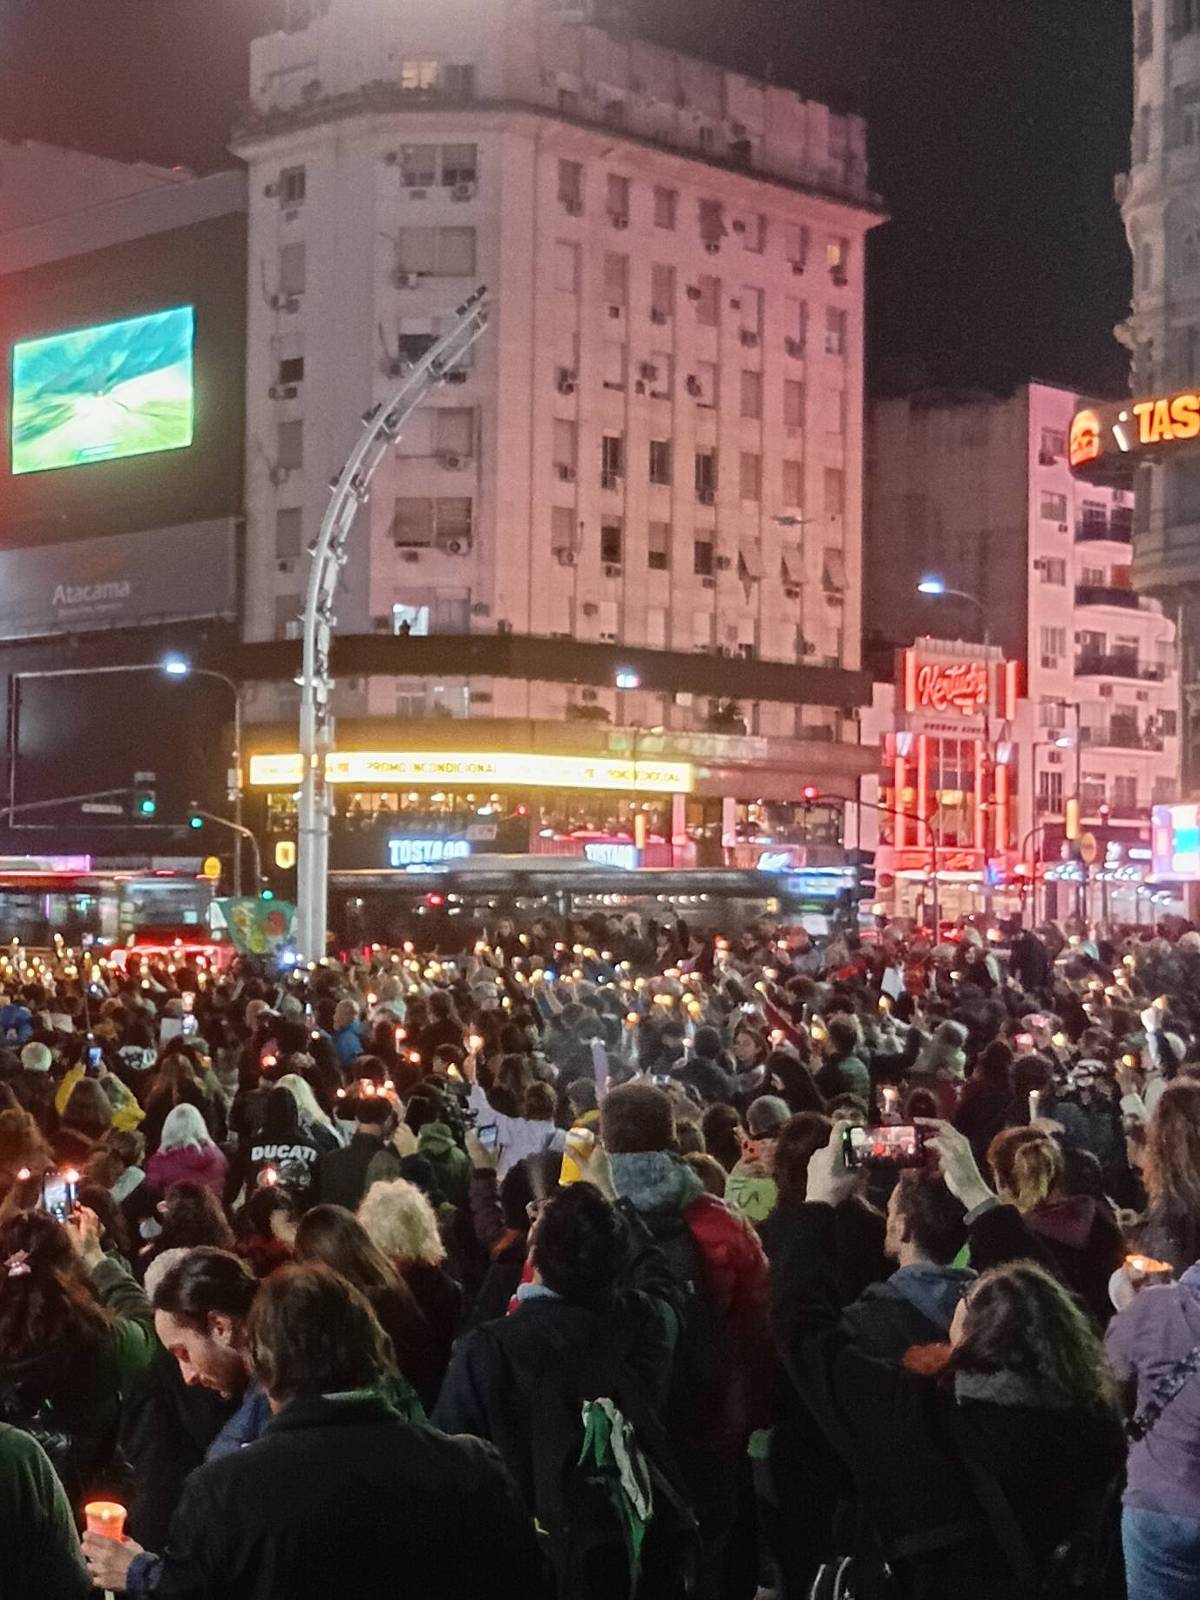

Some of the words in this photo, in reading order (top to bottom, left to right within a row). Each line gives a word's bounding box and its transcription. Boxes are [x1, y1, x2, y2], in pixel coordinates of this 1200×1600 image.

[1133, 394, 1200, 444] TAS
[52, 582, 129, 605] Atacama
[918, 662, 987, 711] Kentucky
[251, 1144, 318, 1162] DUCATI
